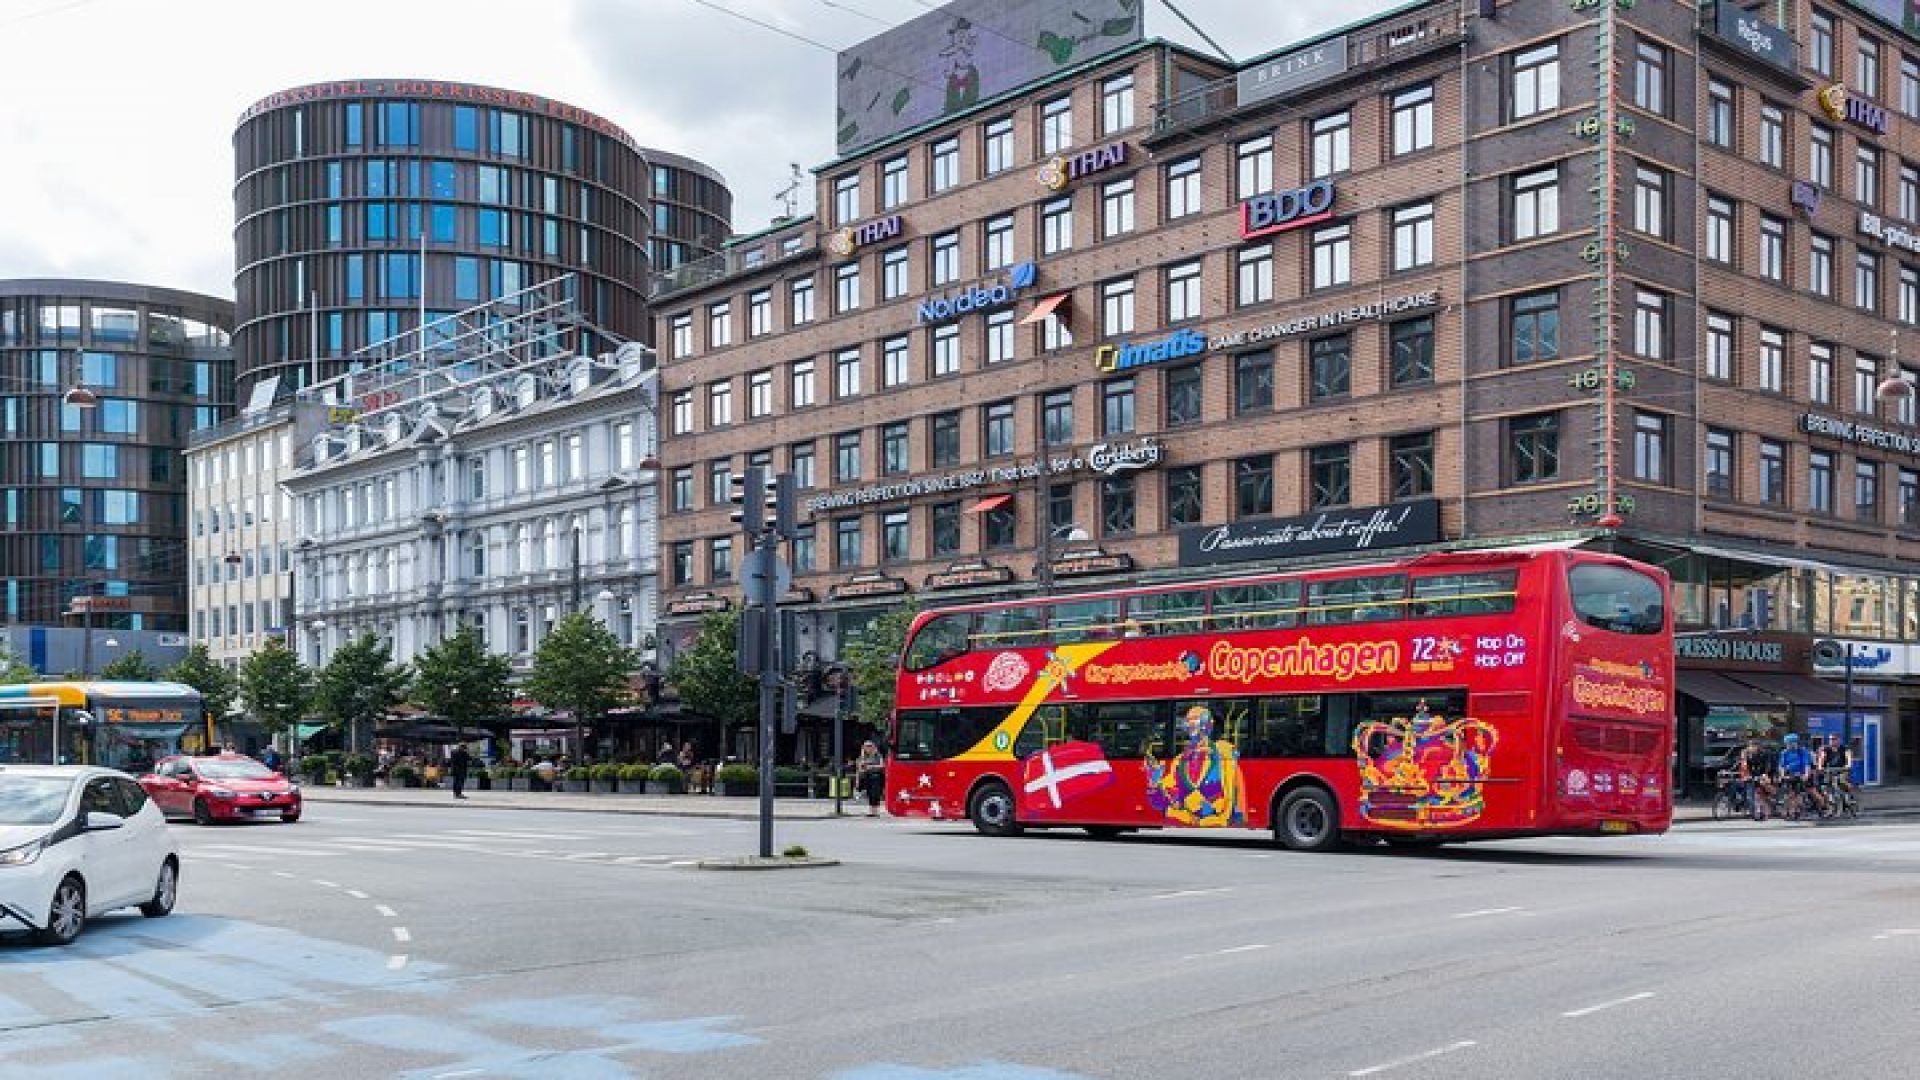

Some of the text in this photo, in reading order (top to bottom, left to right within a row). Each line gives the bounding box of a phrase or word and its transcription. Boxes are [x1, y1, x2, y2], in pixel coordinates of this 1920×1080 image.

[1258, 49, 1324, 82] BRINK
[1847, 97, 1888, 135] THAI
[1067, 142, 1129, 179] THAI
[1250, 179, 1337, 229] BDO
[853, 215, 902, 246] THAI
[917, 283, 1010, 323] Nordea
[1250, 316, 1319, 342] CHANGER
[1320, 311, 1335, 328] IN
[1338, 290, 1440, 322] HEALTHCARE
[1808, 413, 1853, 439] BREWING
[1856, 424, 1911, 451] PERFECTION
[807, 492, 855, 512] BREWING
[856, 480, 921, 503] PERFECTION
[923, 474, 957, 494] SINCE
[1088, 439, 1160, 475] Carlsberg
[1200, 506, 1411, 551] Passionate about coffee!
[1209, 636, 1400, 684] Copenhagen
[1411, 636, 1436, 660] 72
[1474, 651, 1526, 669] Hop Off
[1476, 632, 1526, 650] Hop On
[1732, 640, 1782, 661] HOUSE
[1572, 673, 1665, 714] Copenhagen
